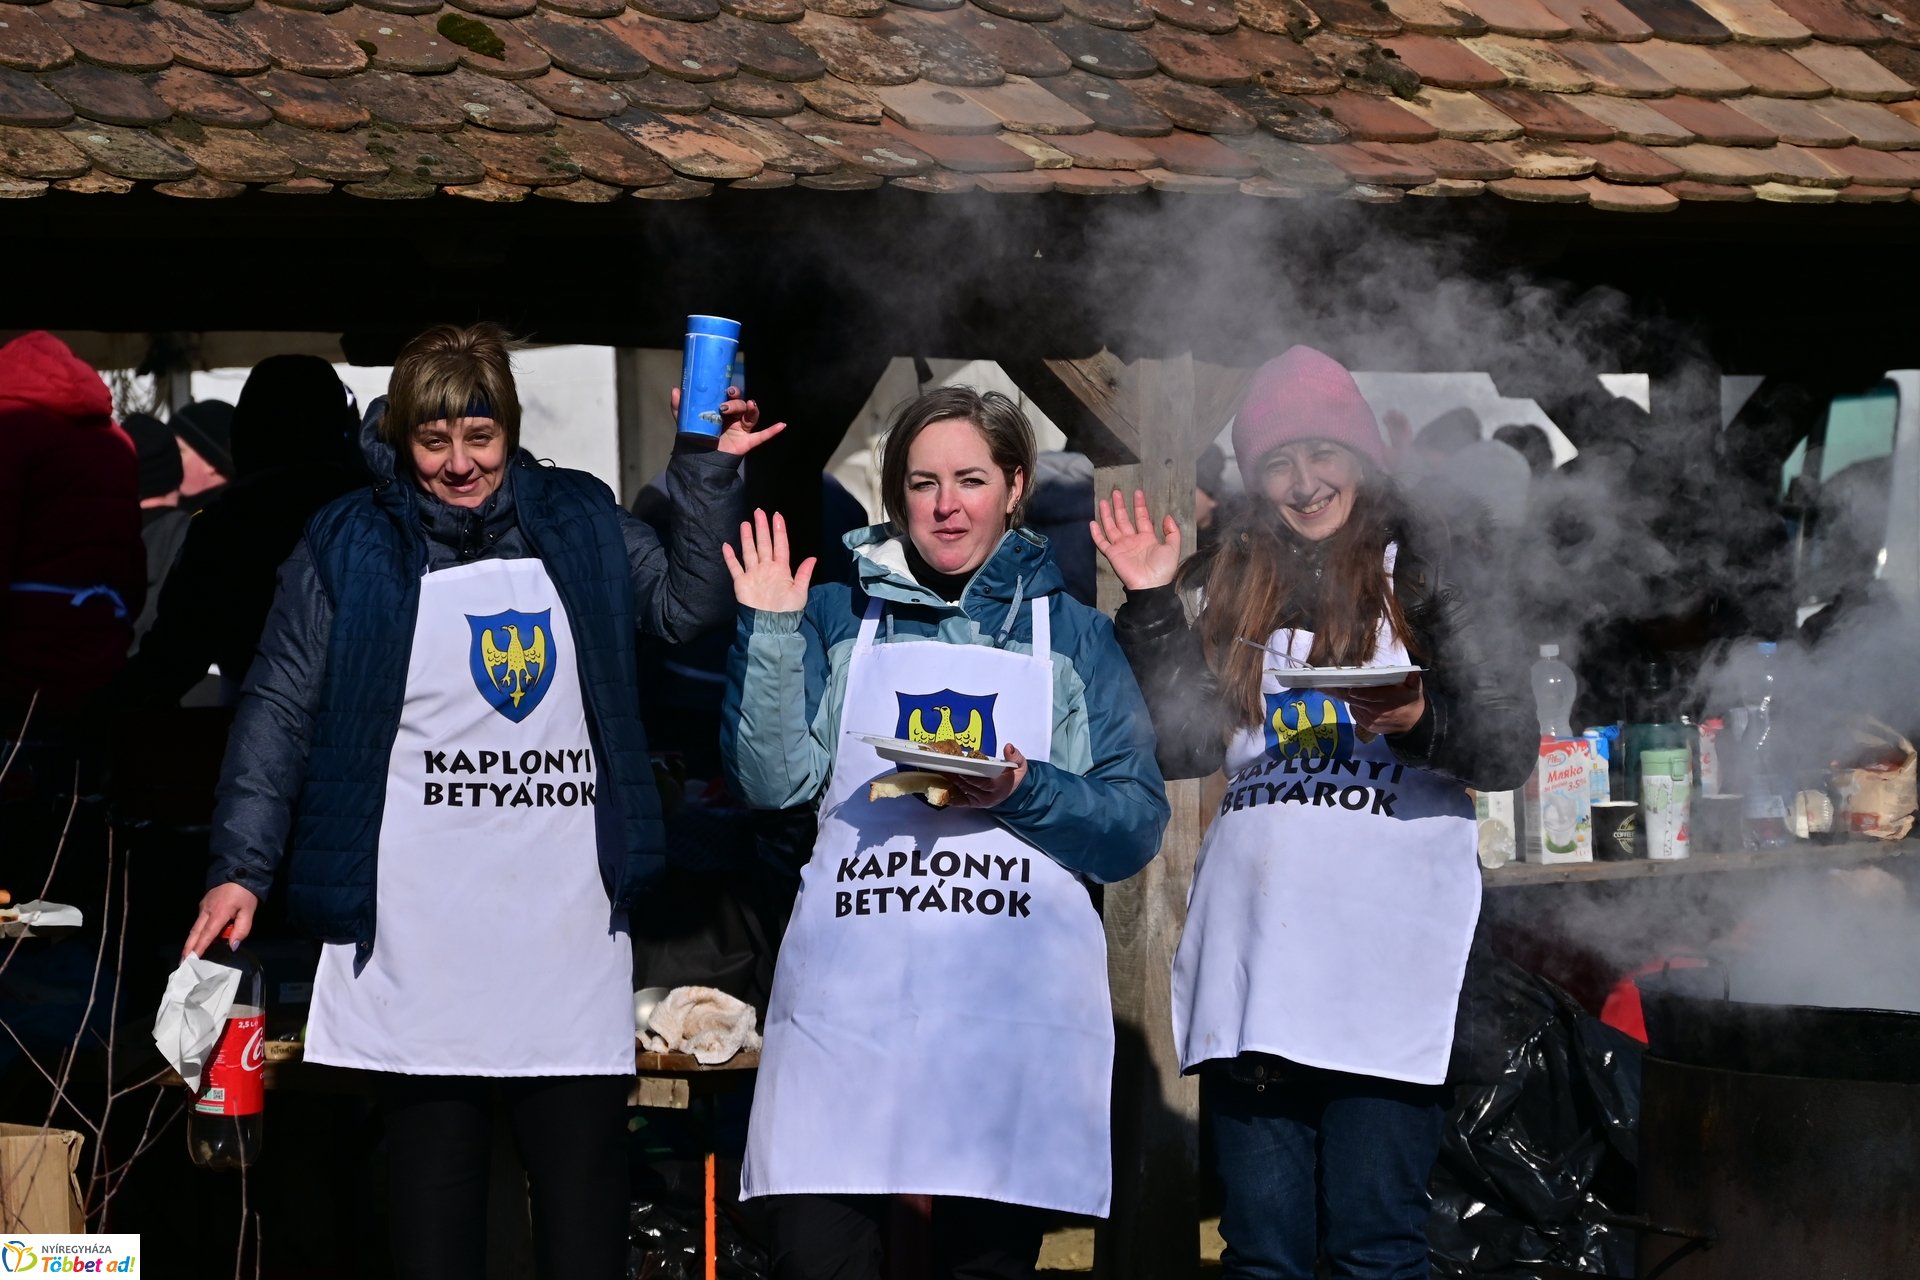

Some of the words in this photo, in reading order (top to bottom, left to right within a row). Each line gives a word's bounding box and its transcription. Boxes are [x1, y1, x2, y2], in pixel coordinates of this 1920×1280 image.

[424, 749, 592, 775] KAPLONYI
[423, 776, 596, 808] BETYÁROK
[1221, 775, 1398, 817] BETYÁROK
[836, 850, 1030, 883] KAPLONYI
[835, 878, 1032, 918] BETYÁROK
